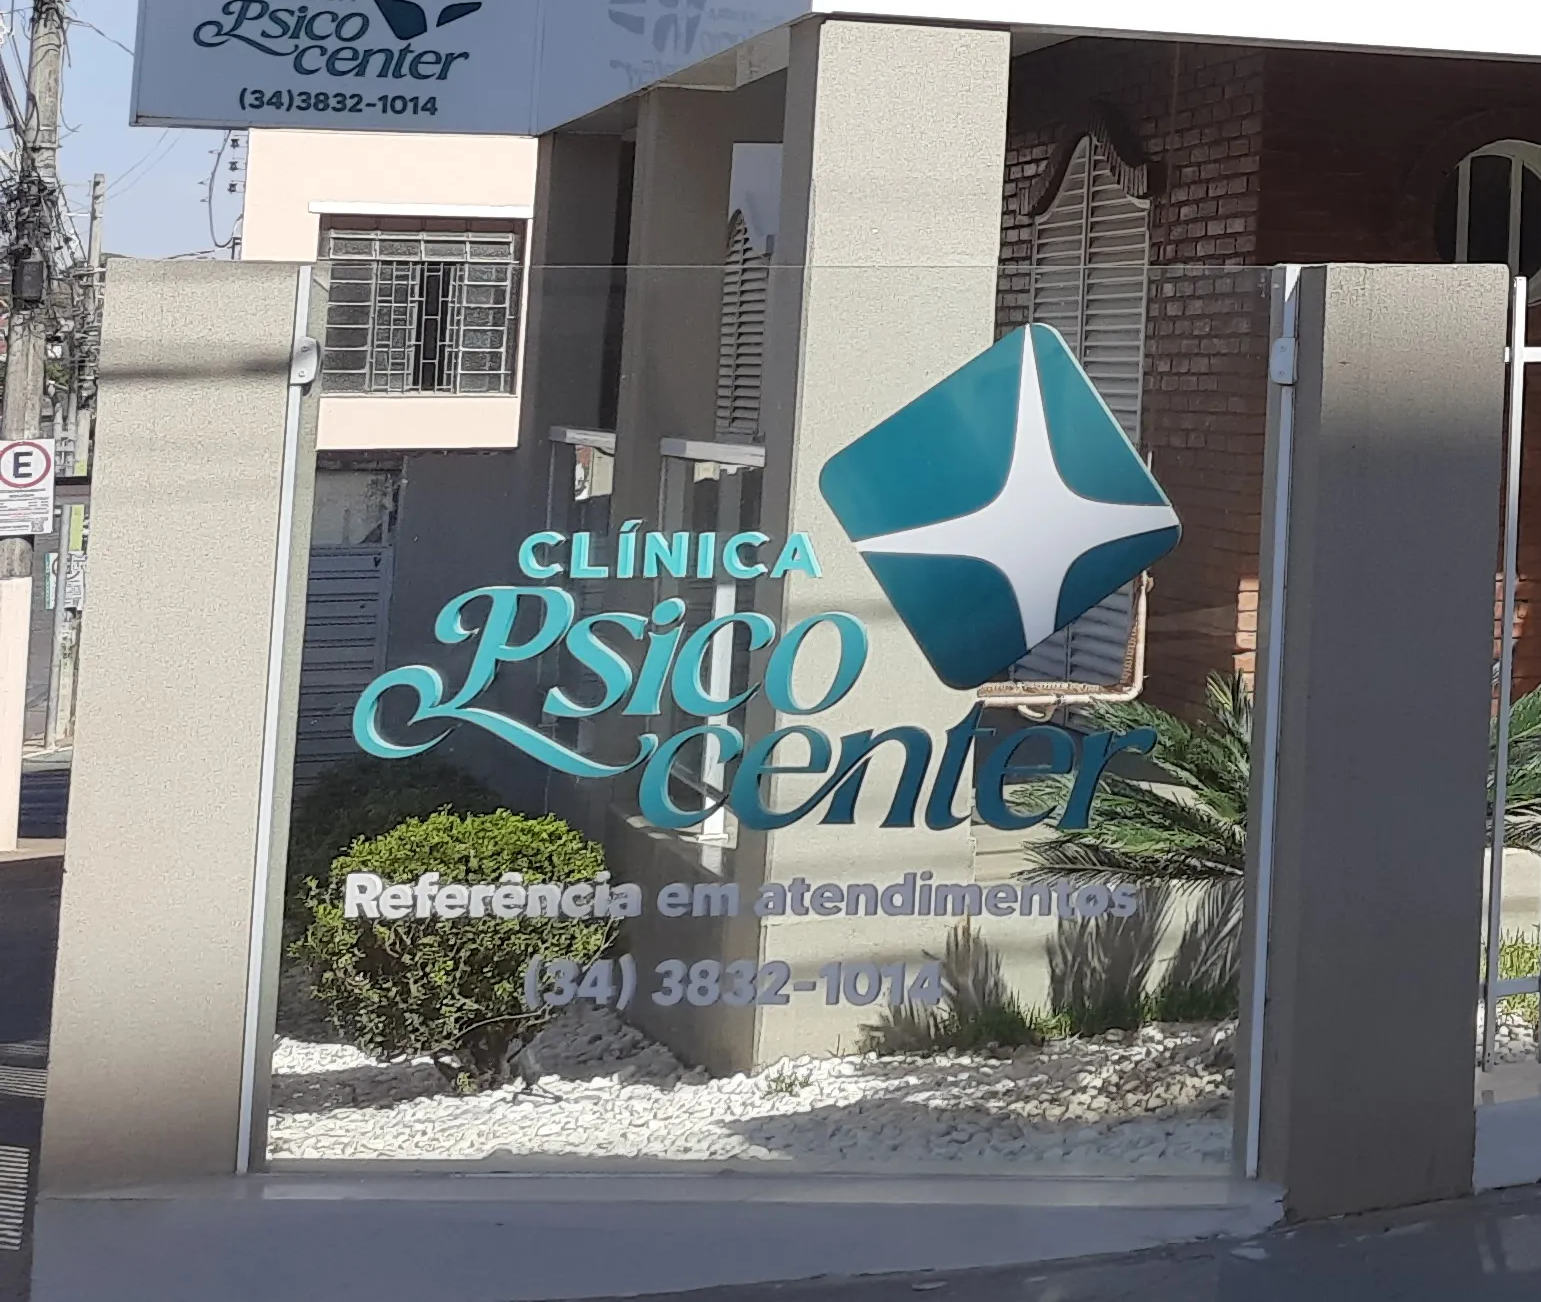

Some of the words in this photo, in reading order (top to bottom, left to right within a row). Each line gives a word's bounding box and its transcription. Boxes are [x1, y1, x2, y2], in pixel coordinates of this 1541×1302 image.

[293, 42, 470, 81] center
[239, 86, 439, 117] (34)3832-1014
[13, 450, 34, 479] E
[518, 519, 822, 581] CLÍNICA
[352, 584, 869, 779] Psico
[632, 702, 1157, 832] center
[344, 871, 642, 921] Referência
[656, 884, 739, 920] em
[755, 871, 1139, 921] atendimentos
[524, 958, 635, 1011] (34)
[651, 960, 946, 1007] 3832-1014
